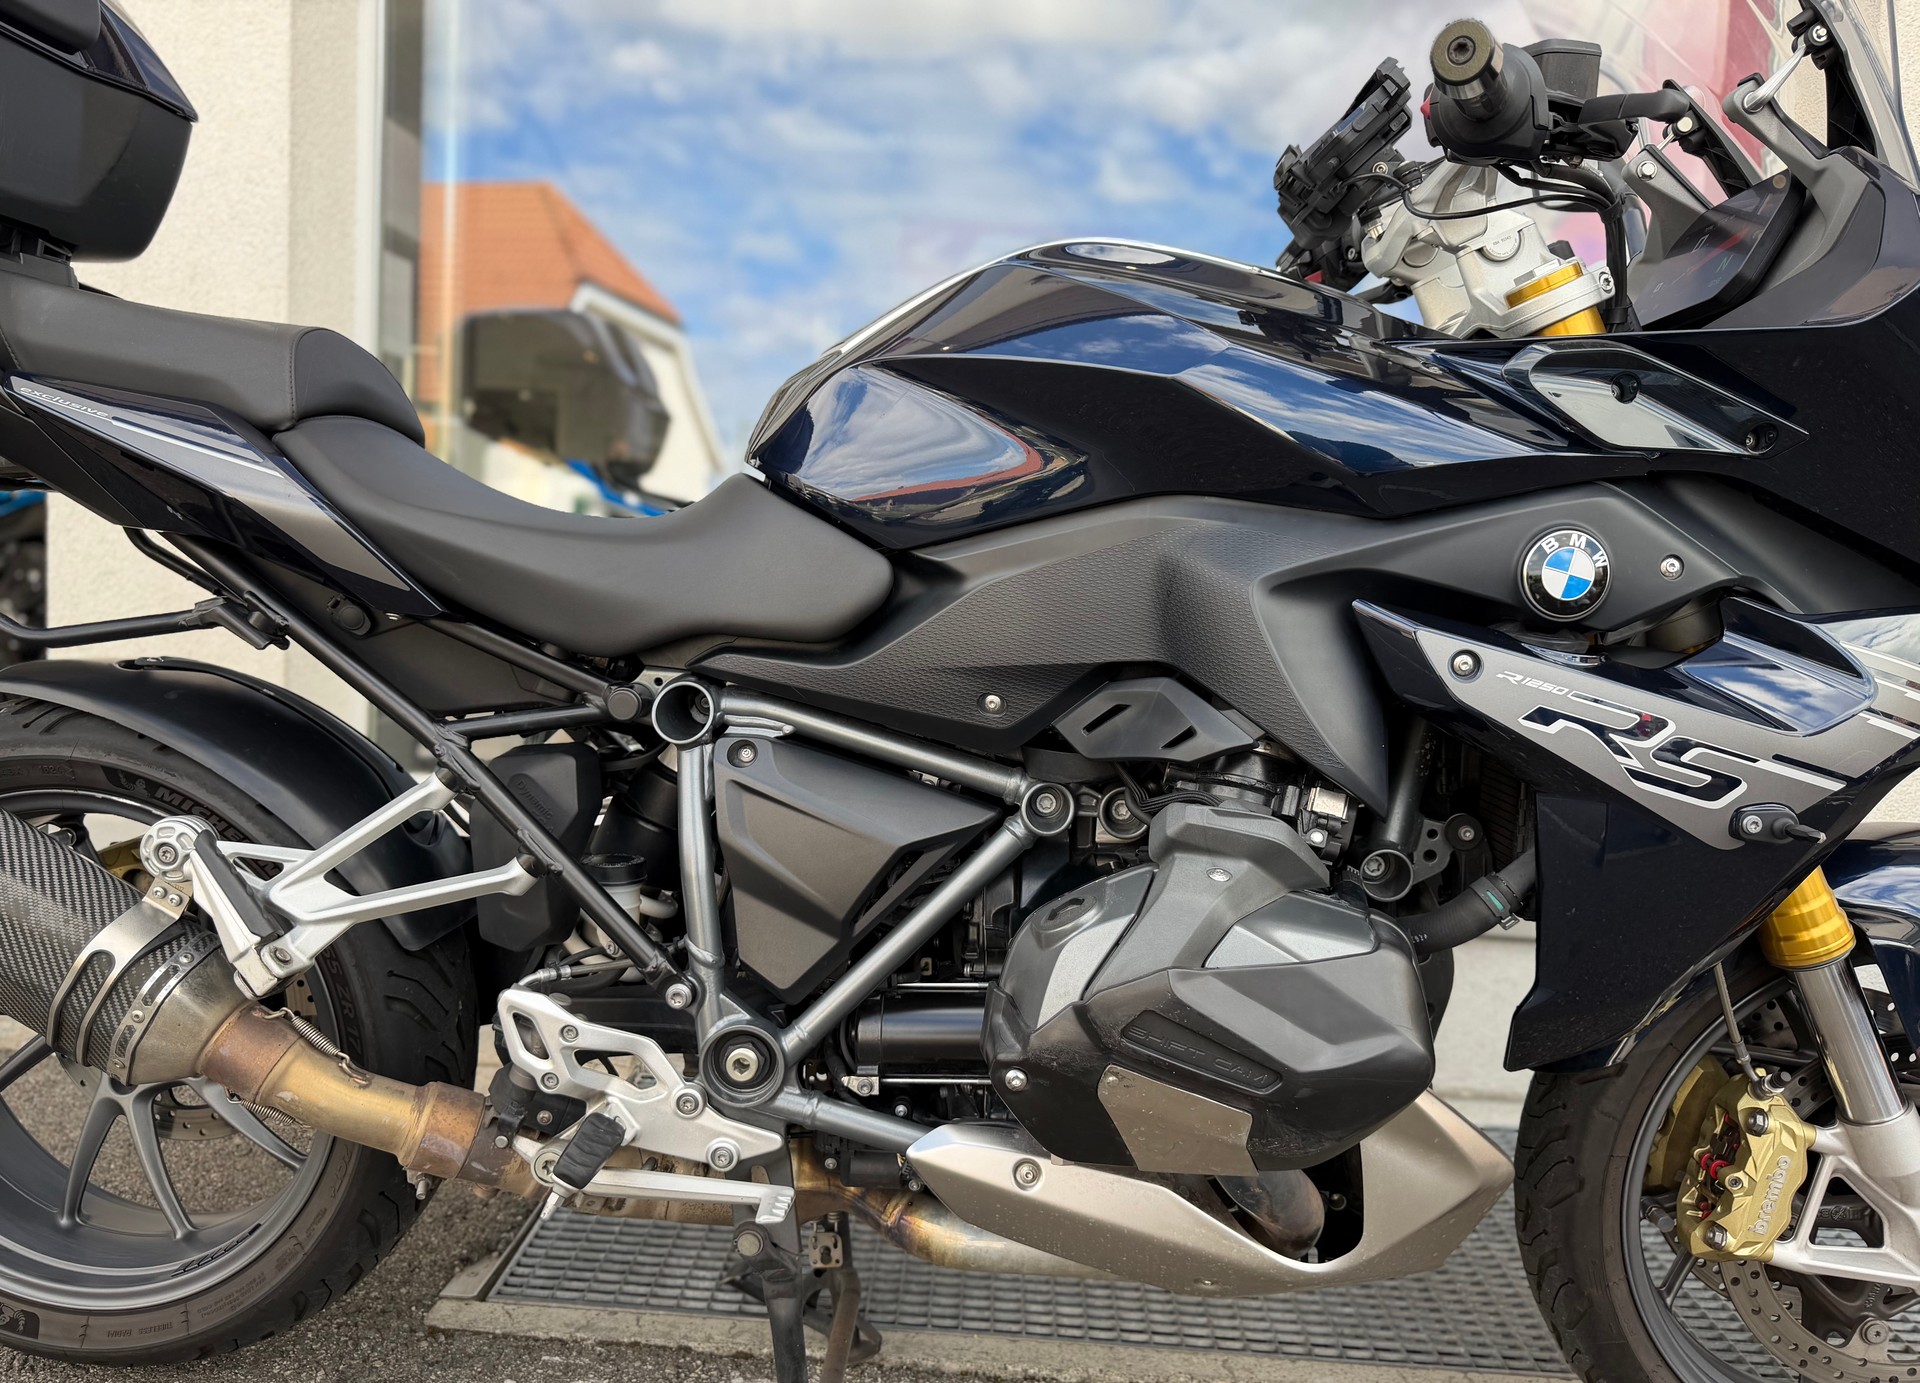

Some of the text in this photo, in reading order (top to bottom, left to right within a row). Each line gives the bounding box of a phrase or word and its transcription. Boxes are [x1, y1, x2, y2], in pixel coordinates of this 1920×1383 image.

[19, 386, 109, 418] exclusive
[1540, 532, 1608, 568] BMW
[1517, 691, 1760, 810] RS
[516, 779, 553, 820] Dynamic
[335, 984, 356, 1019] ZR
[1128, 1025, 1269, 1085] SHIFT CAM
[1748, 1154, 1792, 1236] brembo
